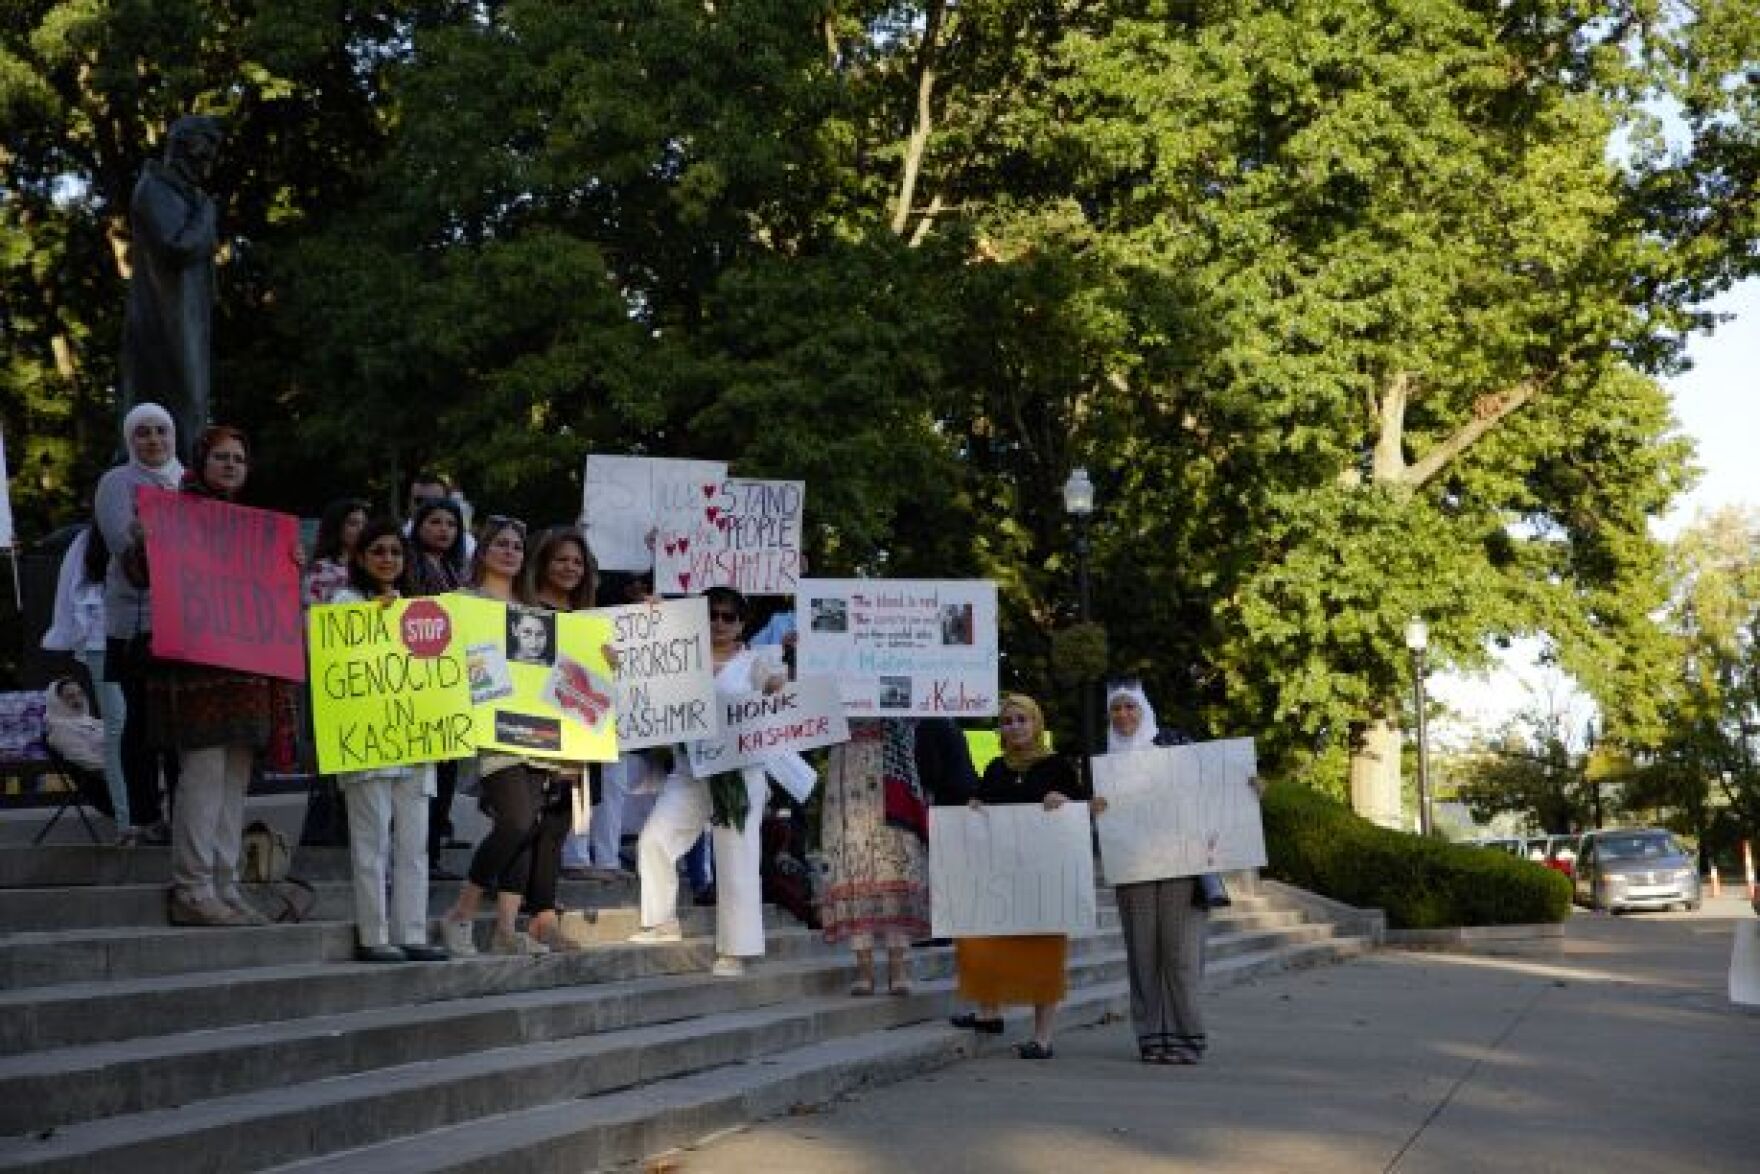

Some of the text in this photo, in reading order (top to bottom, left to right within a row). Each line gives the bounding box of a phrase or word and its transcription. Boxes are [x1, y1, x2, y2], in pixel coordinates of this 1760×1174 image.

[721, 481, 800, 514] STAND
[727, 515, 794, 549] PEOPLE
[320, 609, 391, 649] INDIA
[406, 618, 445, 643] STOP
[615, 609, 663, 642] STOP
[324, 652, 461, 700] GENOCID
[386, 696, 415, 726] IN
[727, 693, 798, 726] HONK
[339, 713, 474, 766] KASHMIR
[738, 716, 830, 755] KASHMIR
